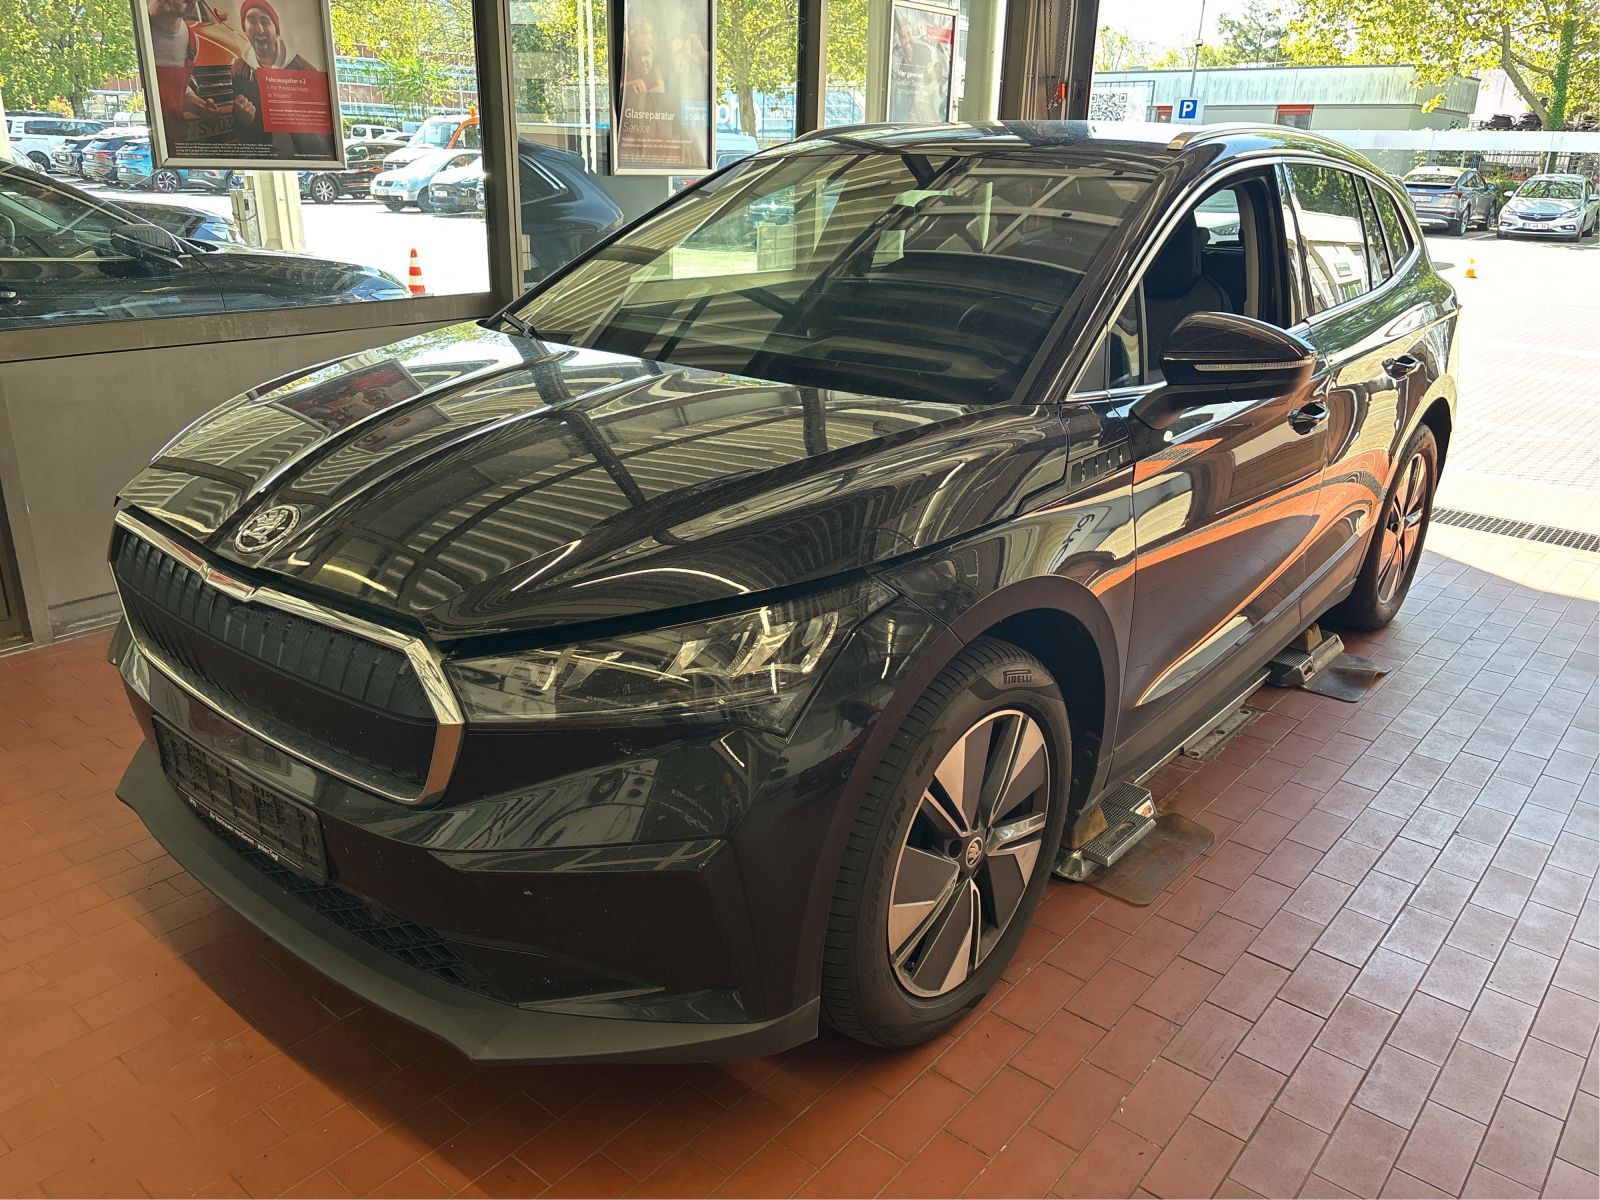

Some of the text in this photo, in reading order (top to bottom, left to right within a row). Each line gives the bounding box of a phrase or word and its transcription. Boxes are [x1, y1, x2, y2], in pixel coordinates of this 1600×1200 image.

[624, 108, 676, 122] Glasreparatur
[1181, 101, 1194, 118] P
[623, 121, 651, 133] Service
[1003, 669, 1032, 685] PIRELLI
